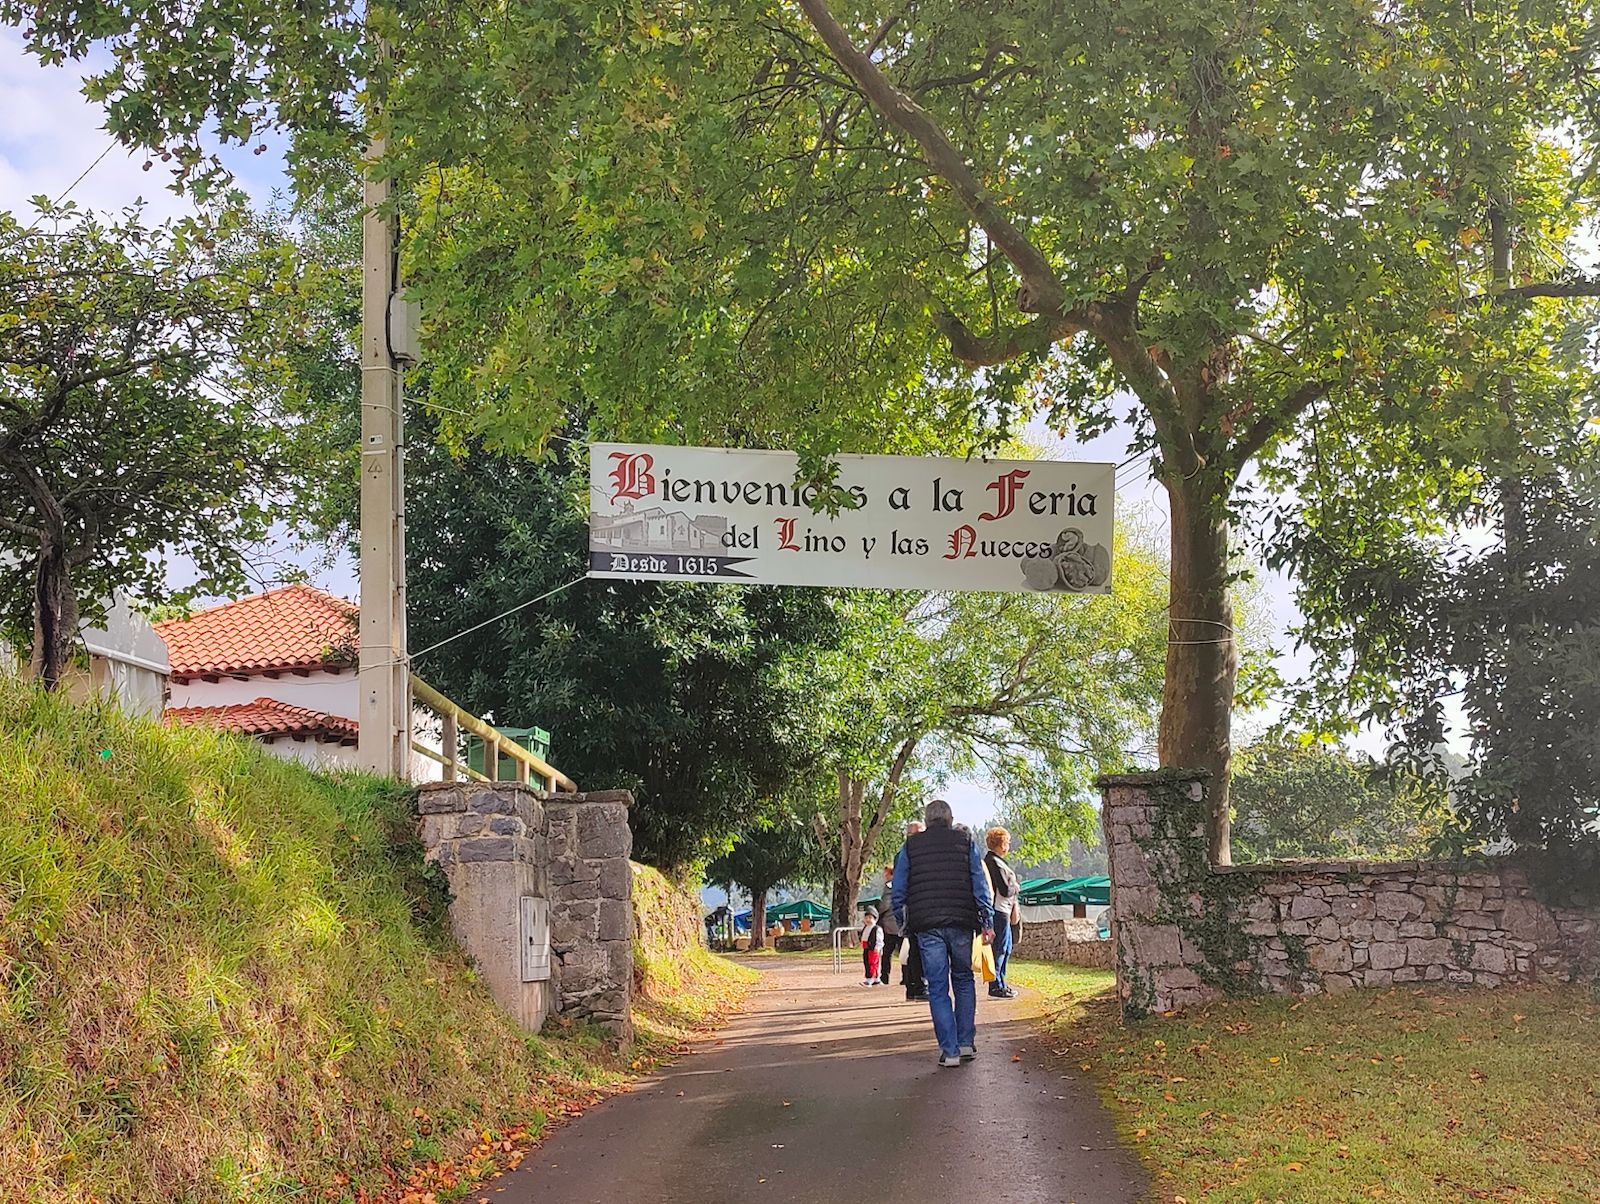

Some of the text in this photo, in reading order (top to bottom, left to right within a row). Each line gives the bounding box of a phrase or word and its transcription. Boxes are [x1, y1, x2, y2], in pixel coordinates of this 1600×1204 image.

[888, 487, 911, 510] a
[932, 477, 964, 512] la
[978, 469, 1098, 521] Feria
[721, 517, 1052, 560] del Lino y las Nueces
[610, 553, 719, 575] Desde 1615
